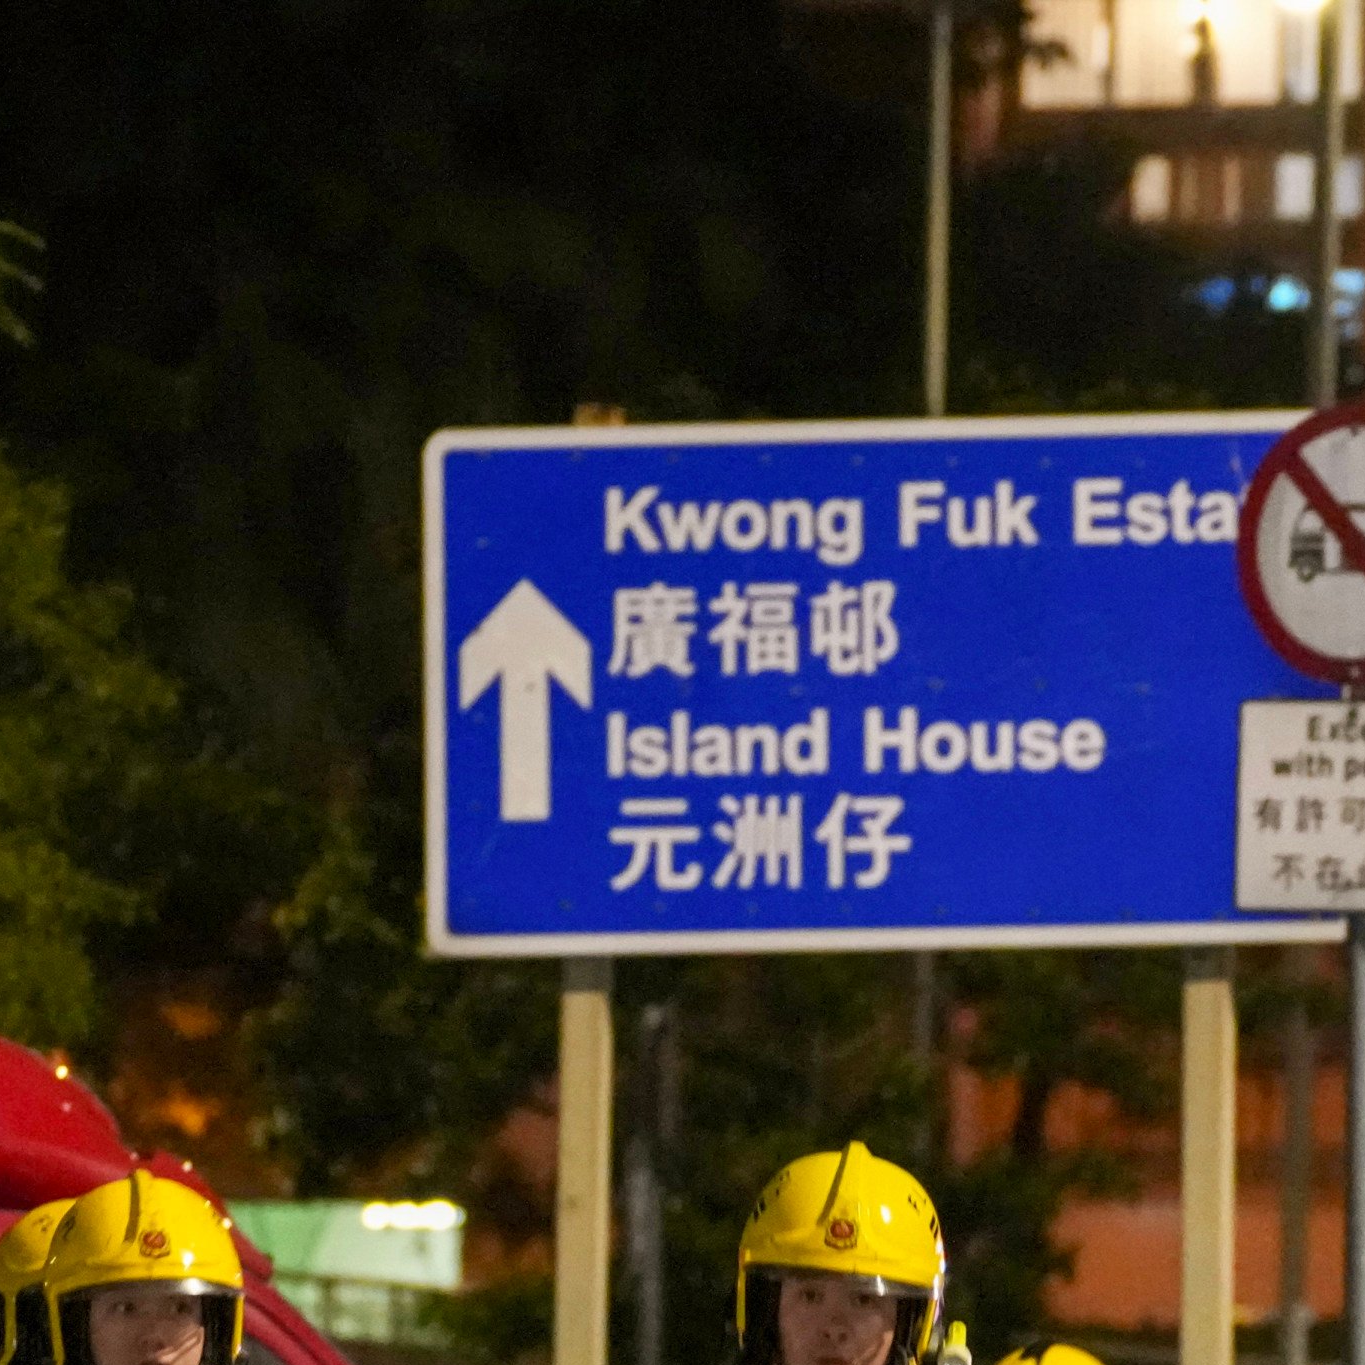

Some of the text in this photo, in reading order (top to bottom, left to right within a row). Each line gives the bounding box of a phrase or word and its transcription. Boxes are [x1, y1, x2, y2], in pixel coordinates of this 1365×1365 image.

[604, 475, 1238, 566] Kwong Fuk Esta
[608, 580, 899, 678] 廣福邨
[607, 706, 1105, 778] Island House
[1271, 752, 1334, 780] with
[608, 794, 912, 891] 元洲仔
